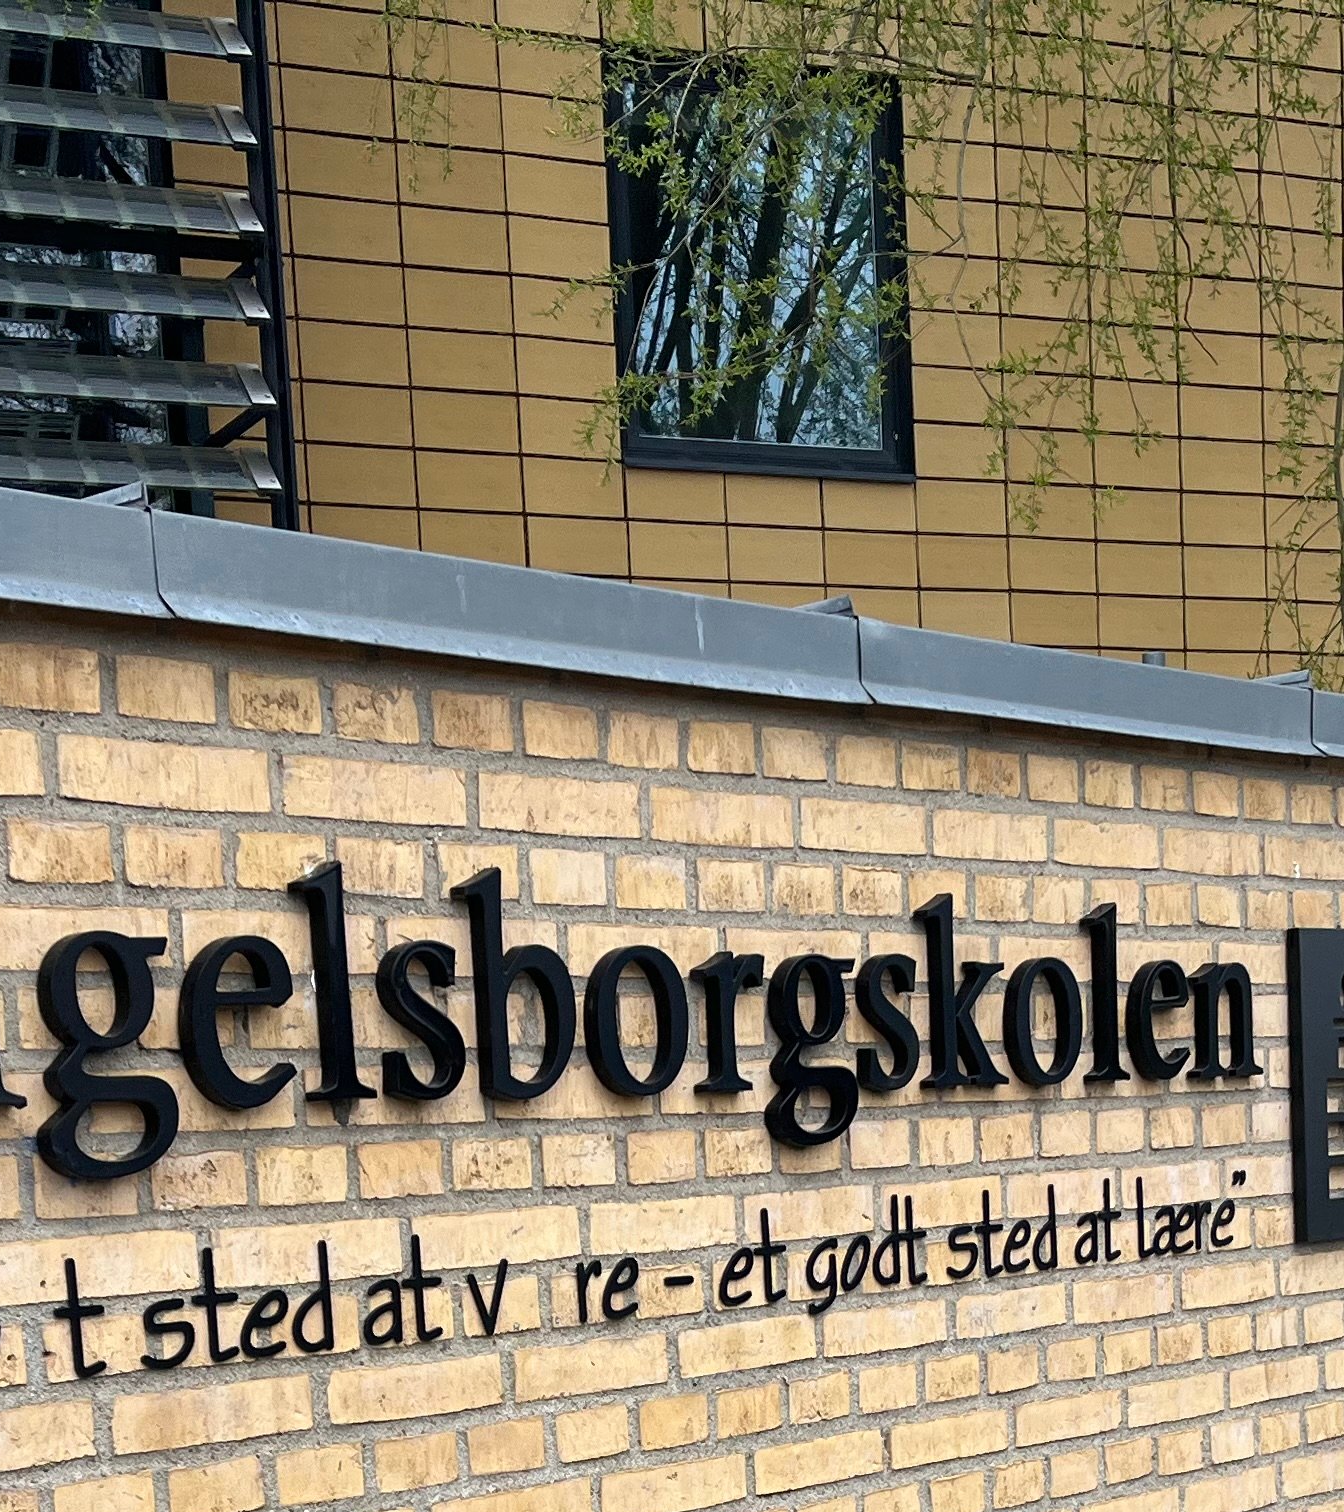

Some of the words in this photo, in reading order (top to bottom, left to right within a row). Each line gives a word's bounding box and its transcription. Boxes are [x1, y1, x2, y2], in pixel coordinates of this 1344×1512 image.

[140, 1240, 335, 1373] sted
[362, 1234, 444, 1347] at
[718, 1208, 787, 1308] et
[805, 1194, 928, 1317] godt
[946, 1184, 1058, 1280] sted
[1074, 1178, 1122, 1265] at
